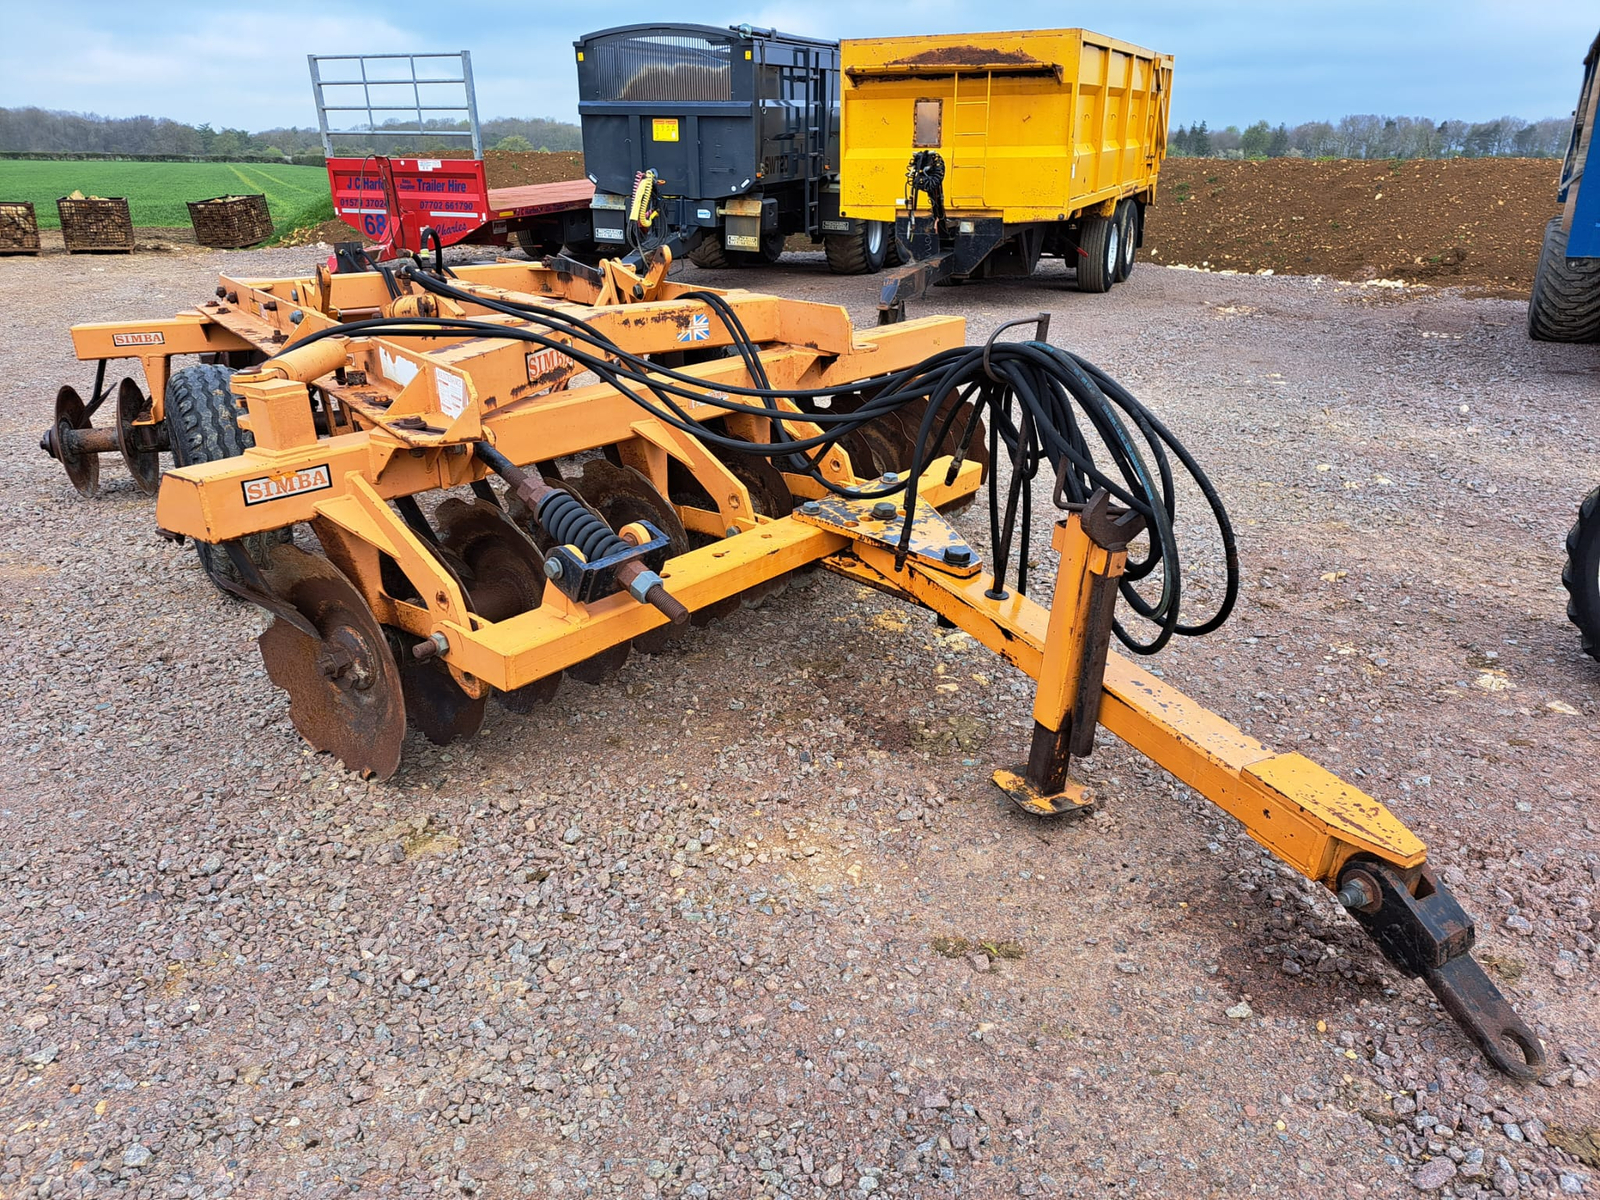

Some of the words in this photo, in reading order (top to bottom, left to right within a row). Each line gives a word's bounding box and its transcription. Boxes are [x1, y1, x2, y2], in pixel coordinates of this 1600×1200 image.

[417, 178, 445, 192] Trailer
[448, 179, 467, 193] Hire
[364, 214, 386, 235] 68
[115, 333, 162, 344] SIMBA
[247, 470, 328, 501] SIMBA
